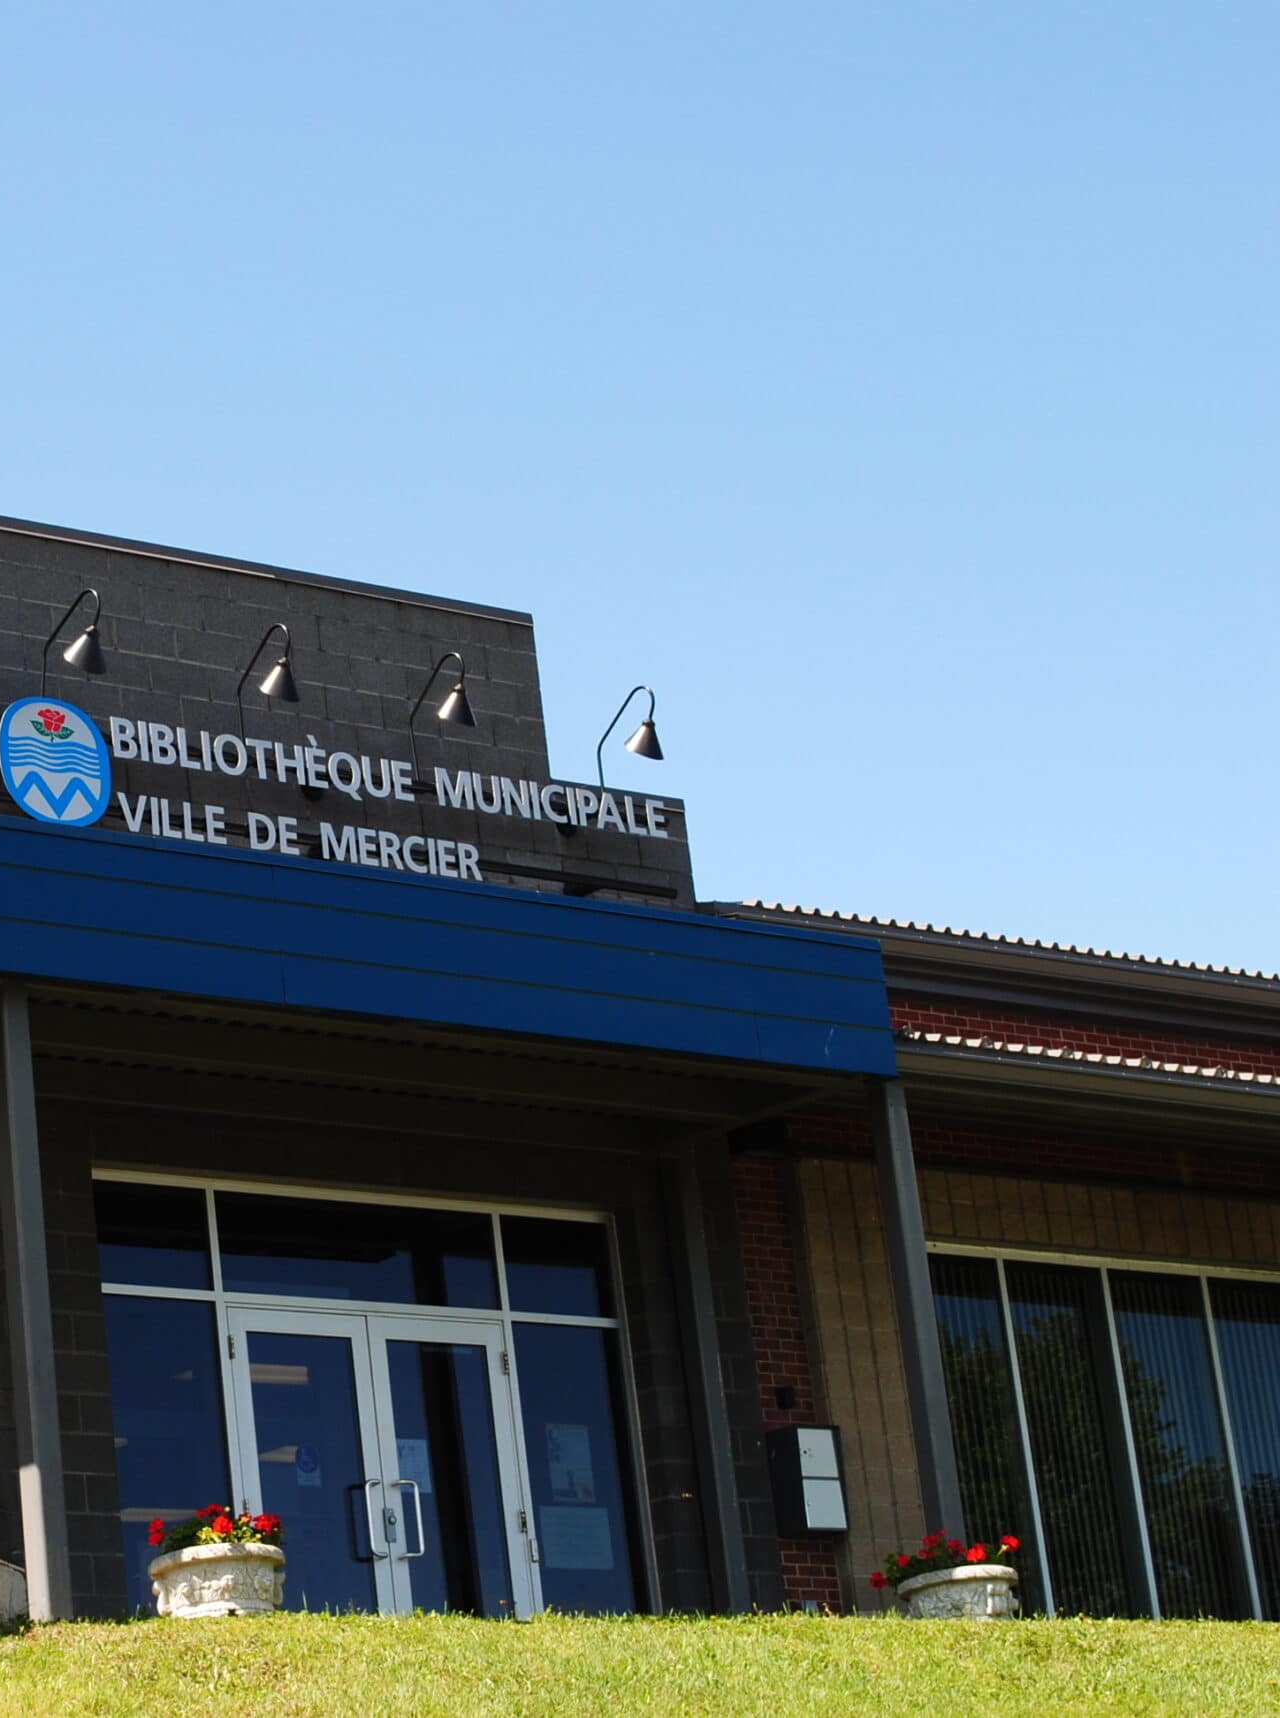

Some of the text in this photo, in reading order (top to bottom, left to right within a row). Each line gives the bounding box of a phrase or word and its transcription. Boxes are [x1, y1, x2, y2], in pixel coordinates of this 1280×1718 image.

[110, 716, 668, 838] BIBLIOTHÈQUE MUNICIPALE
[117, 792, 483, 881] VILLE DE MERCIER
